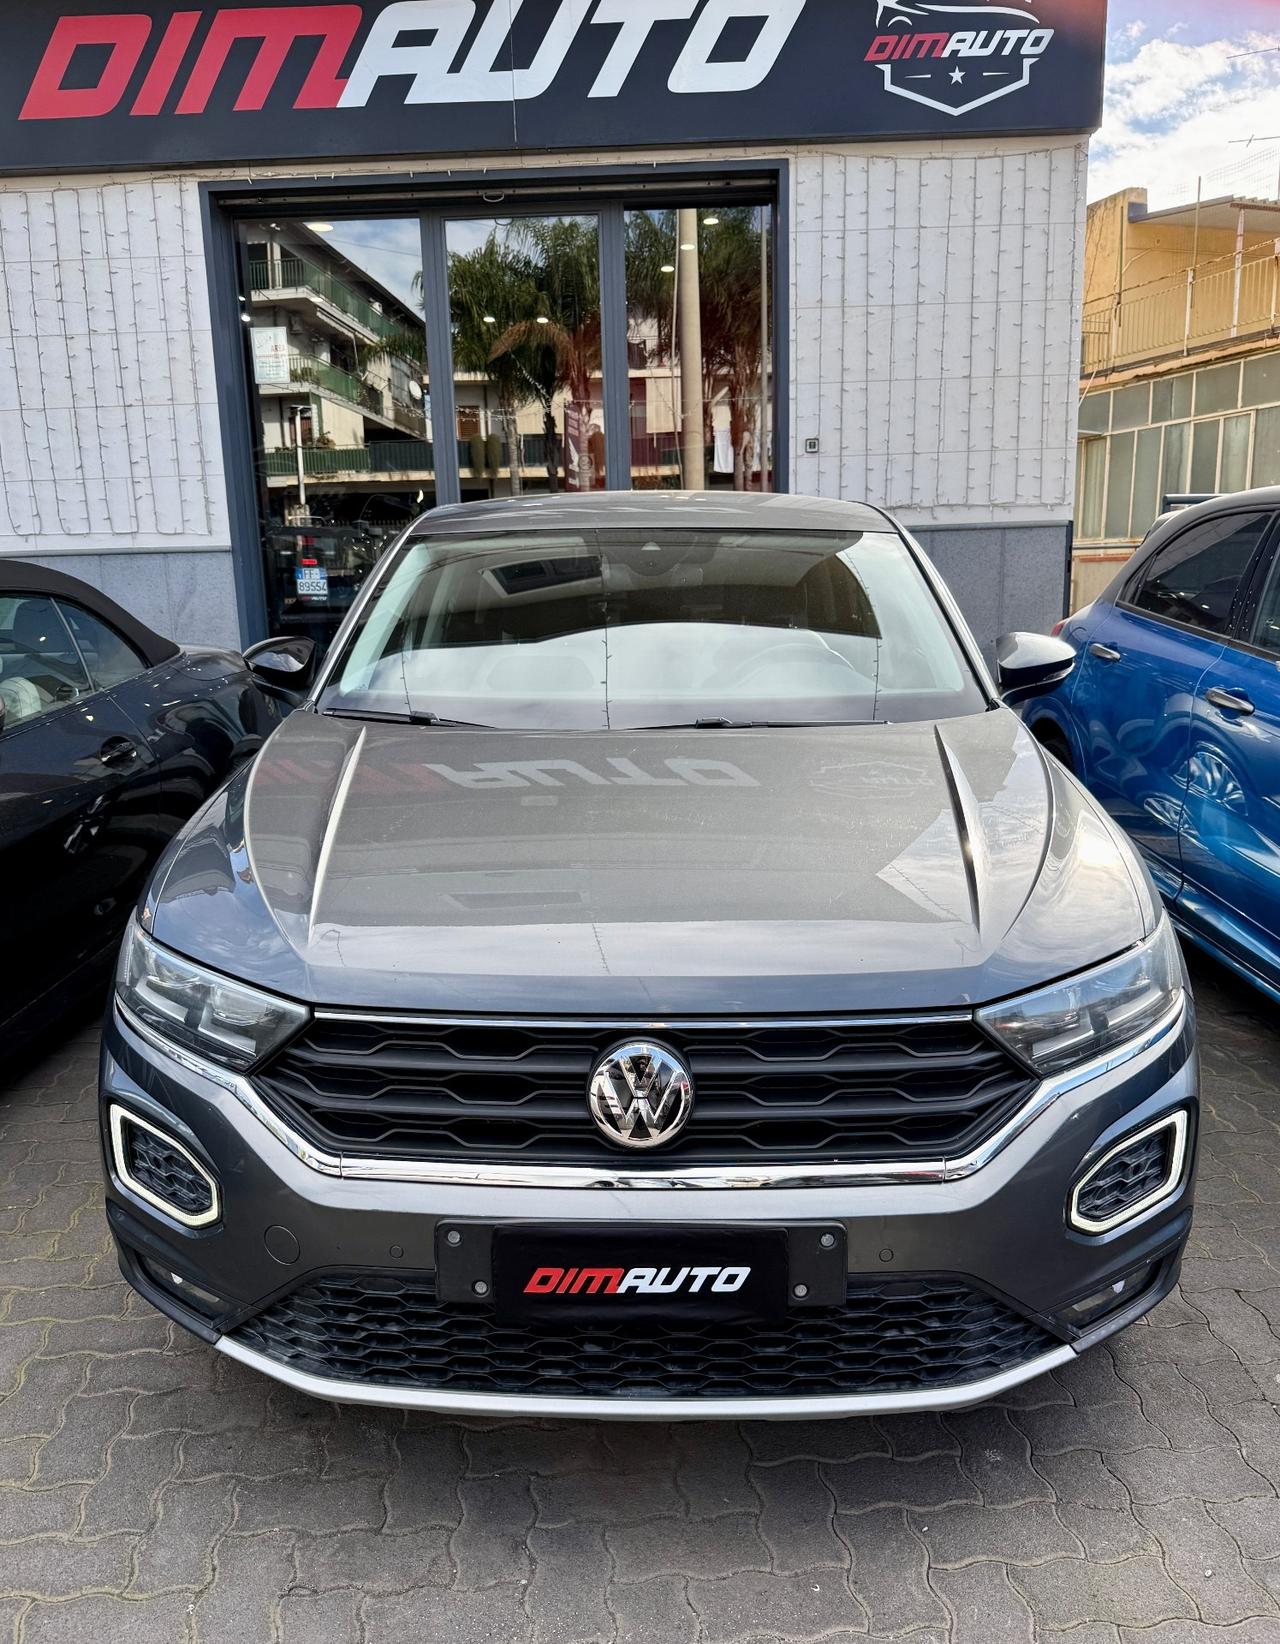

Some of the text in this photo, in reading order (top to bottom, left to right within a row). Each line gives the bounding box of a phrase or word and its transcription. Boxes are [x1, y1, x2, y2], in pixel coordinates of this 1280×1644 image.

[18, 0, 806, 120] DIMAUTO
[864, 28, 1055, 62] DIMAUTO
[299, 581, 327, 592] 89554
[592, 1044, 690, 1147] VW
[523, 1267, 751, 1294] DIMAUTO
